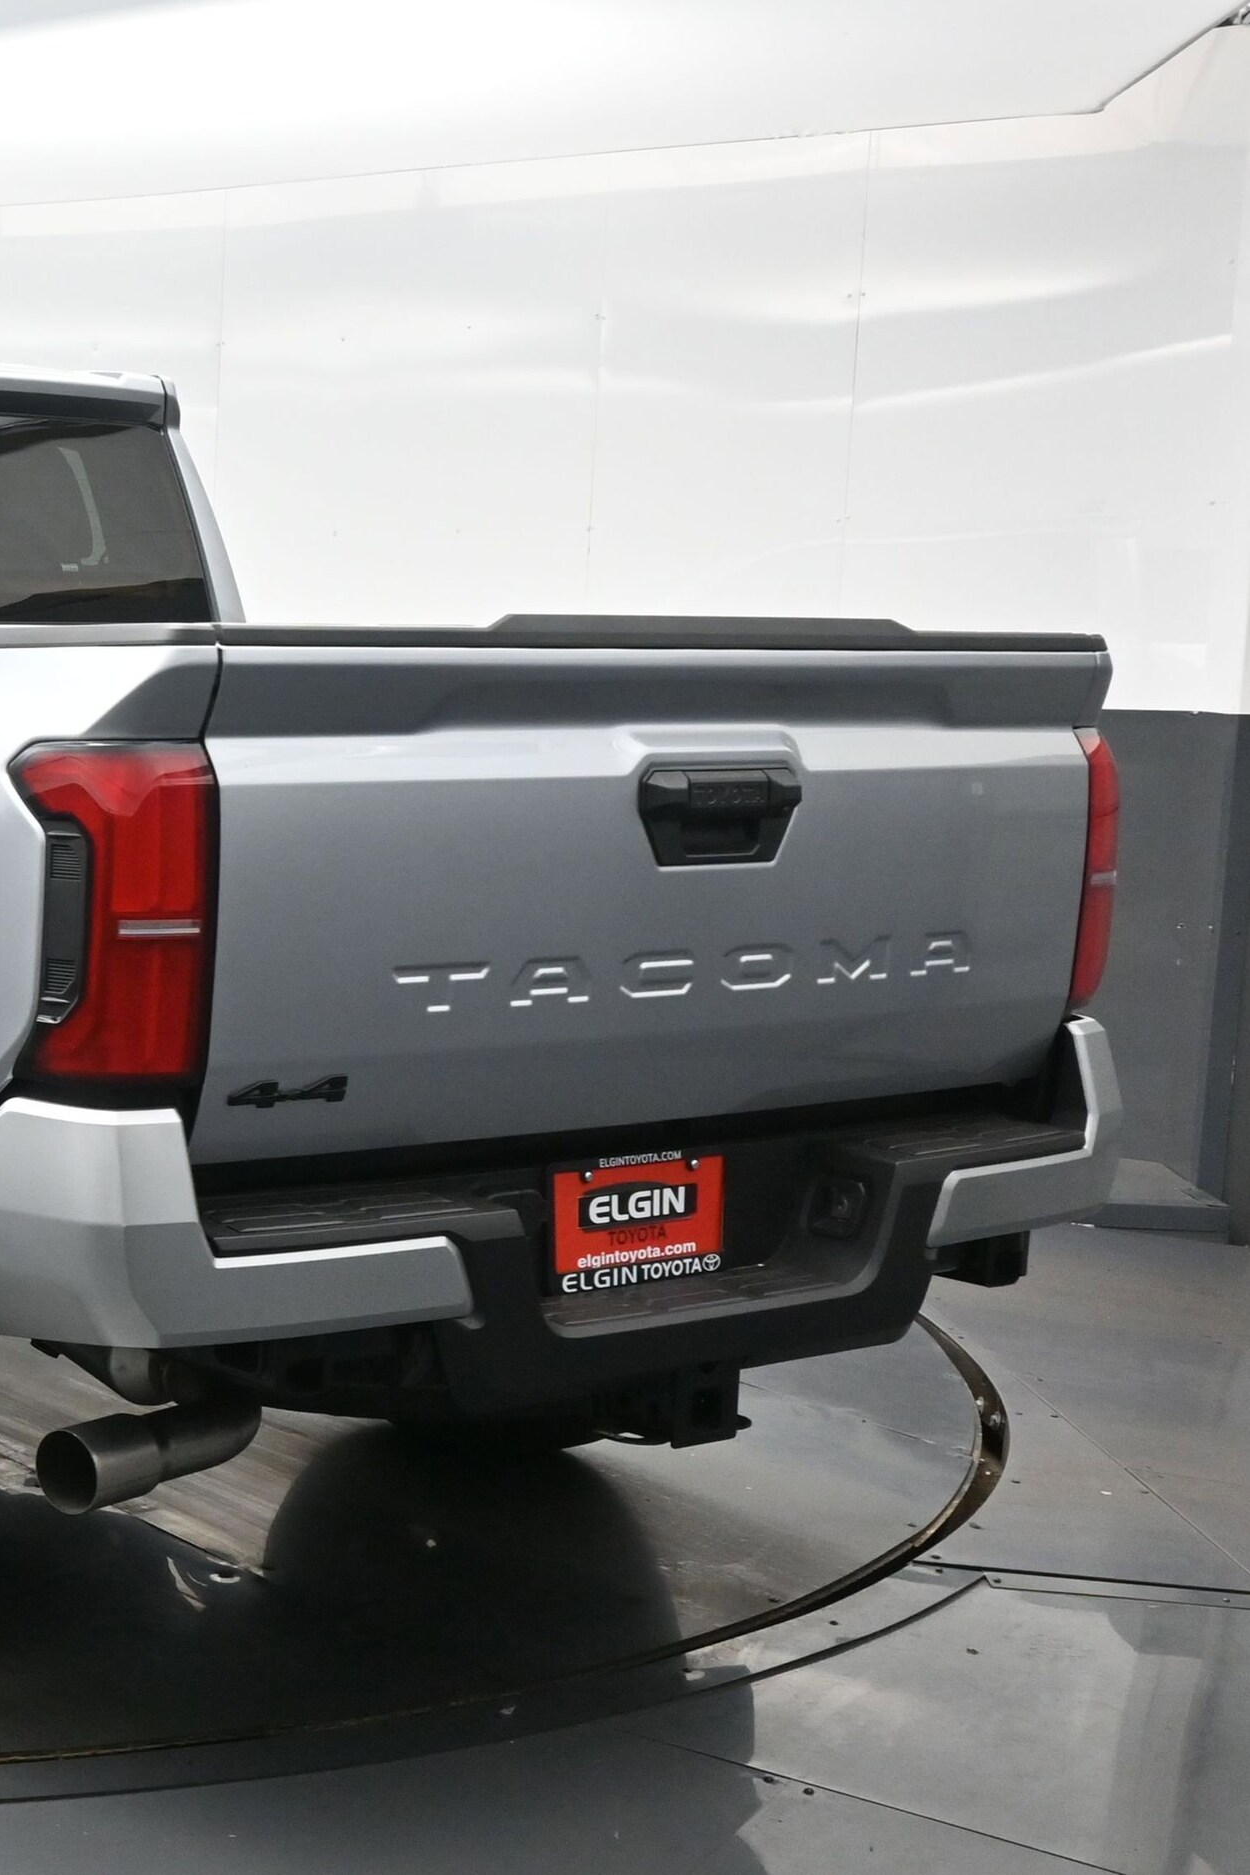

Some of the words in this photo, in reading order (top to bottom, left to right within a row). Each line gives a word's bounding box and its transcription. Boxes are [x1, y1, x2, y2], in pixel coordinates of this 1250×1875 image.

[392, 930, 971, 1012] TACOMA
[599, 1150, 682, 1168] ELGINTOYOTA.COM
[588, 1186, 686, 1224] ELGIN
[607, 1225, 667, 1246] TOYOTA
[577, 1241, 696, 1269] elgintoyota.com
[562, 1266, 638, 1293] ELGIN
[641, 1257, 702, 1280] TOYOTA
